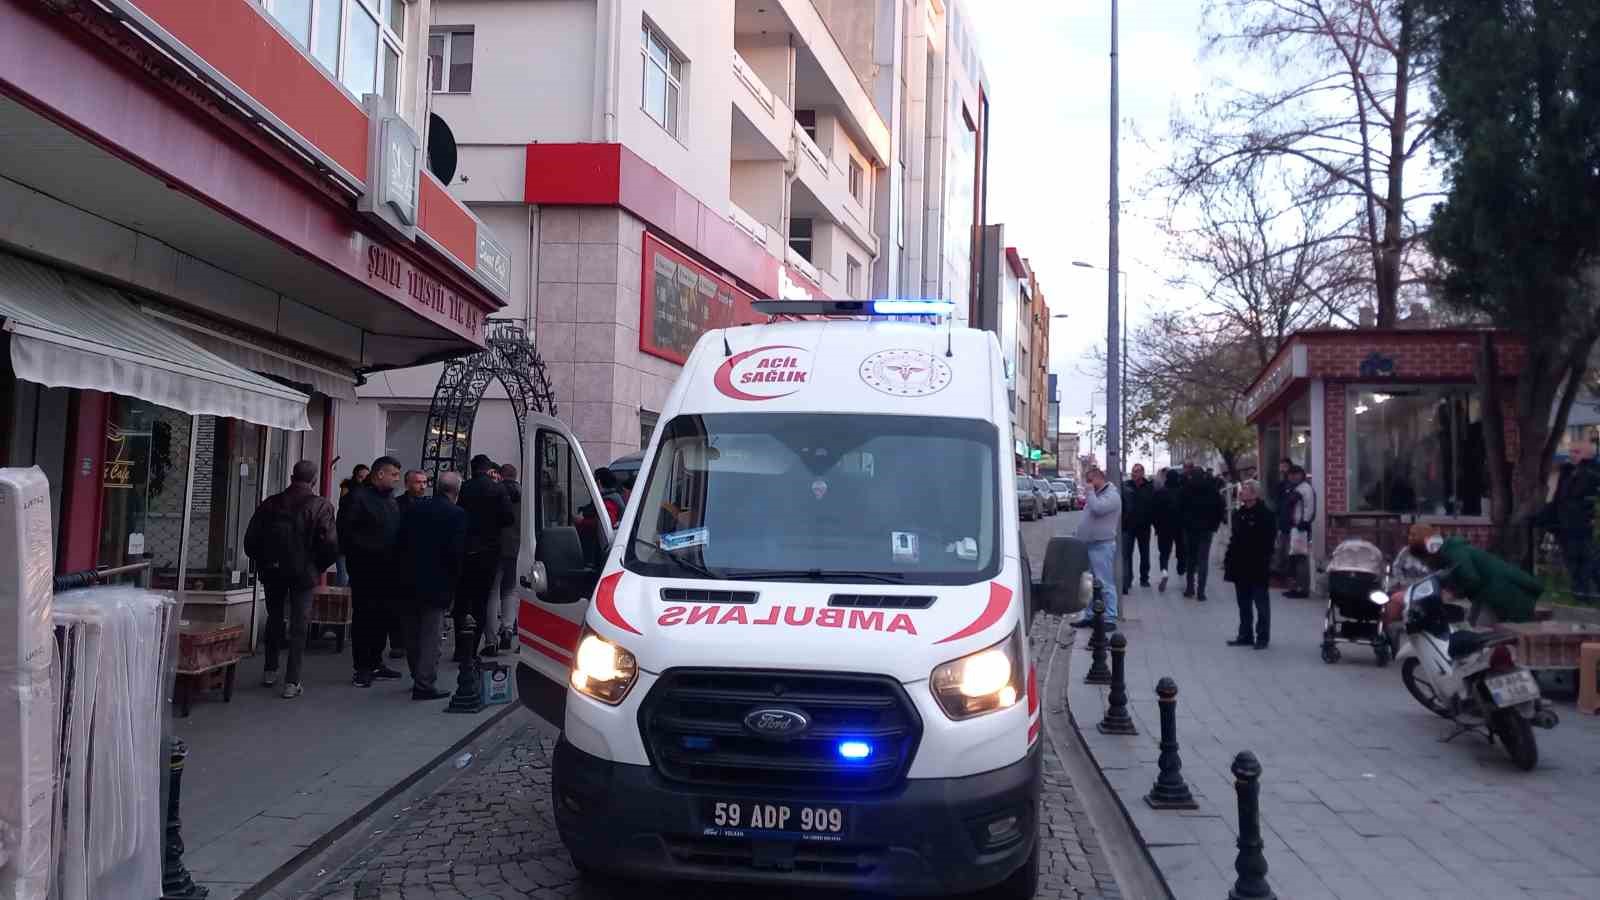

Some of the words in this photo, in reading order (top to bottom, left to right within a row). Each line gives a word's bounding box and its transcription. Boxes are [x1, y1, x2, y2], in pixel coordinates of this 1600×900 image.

[368, 245, 401, 288] ŞENEL
[756, 355, 798, 369] ACİL
[740, 369, 808, 384] SAĞLIK
[757, 713, 792, 729] Ford
[714, 802, 741, 826] 59
[751, 804, 791, 829] ADP
[801, 807, 842, 832] 909
